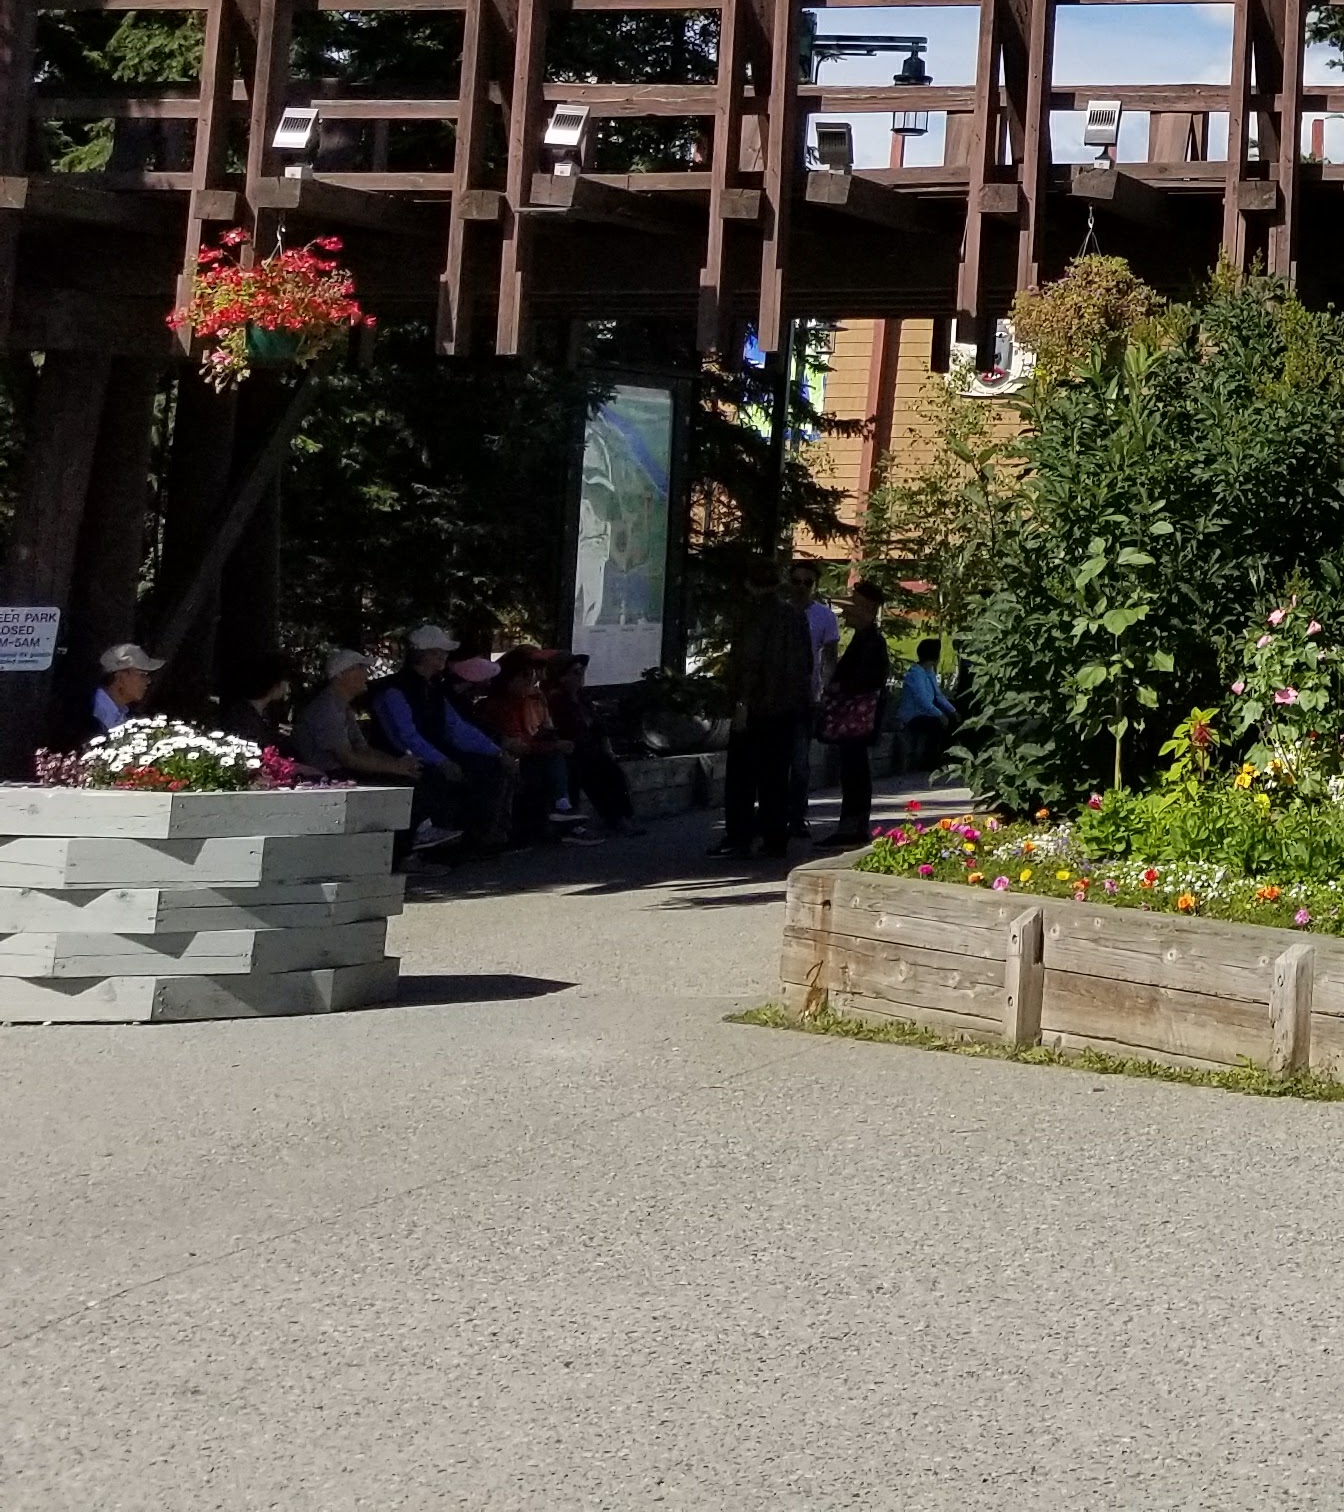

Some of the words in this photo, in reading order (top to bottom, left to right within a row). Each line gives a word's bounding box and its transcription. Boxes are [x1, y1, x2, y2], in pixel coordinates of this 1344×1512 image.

[25, 613, 57, 623] PARK
[1, 626, 35, 635] OSED
[0, 638, 40, 648] M-5AM
